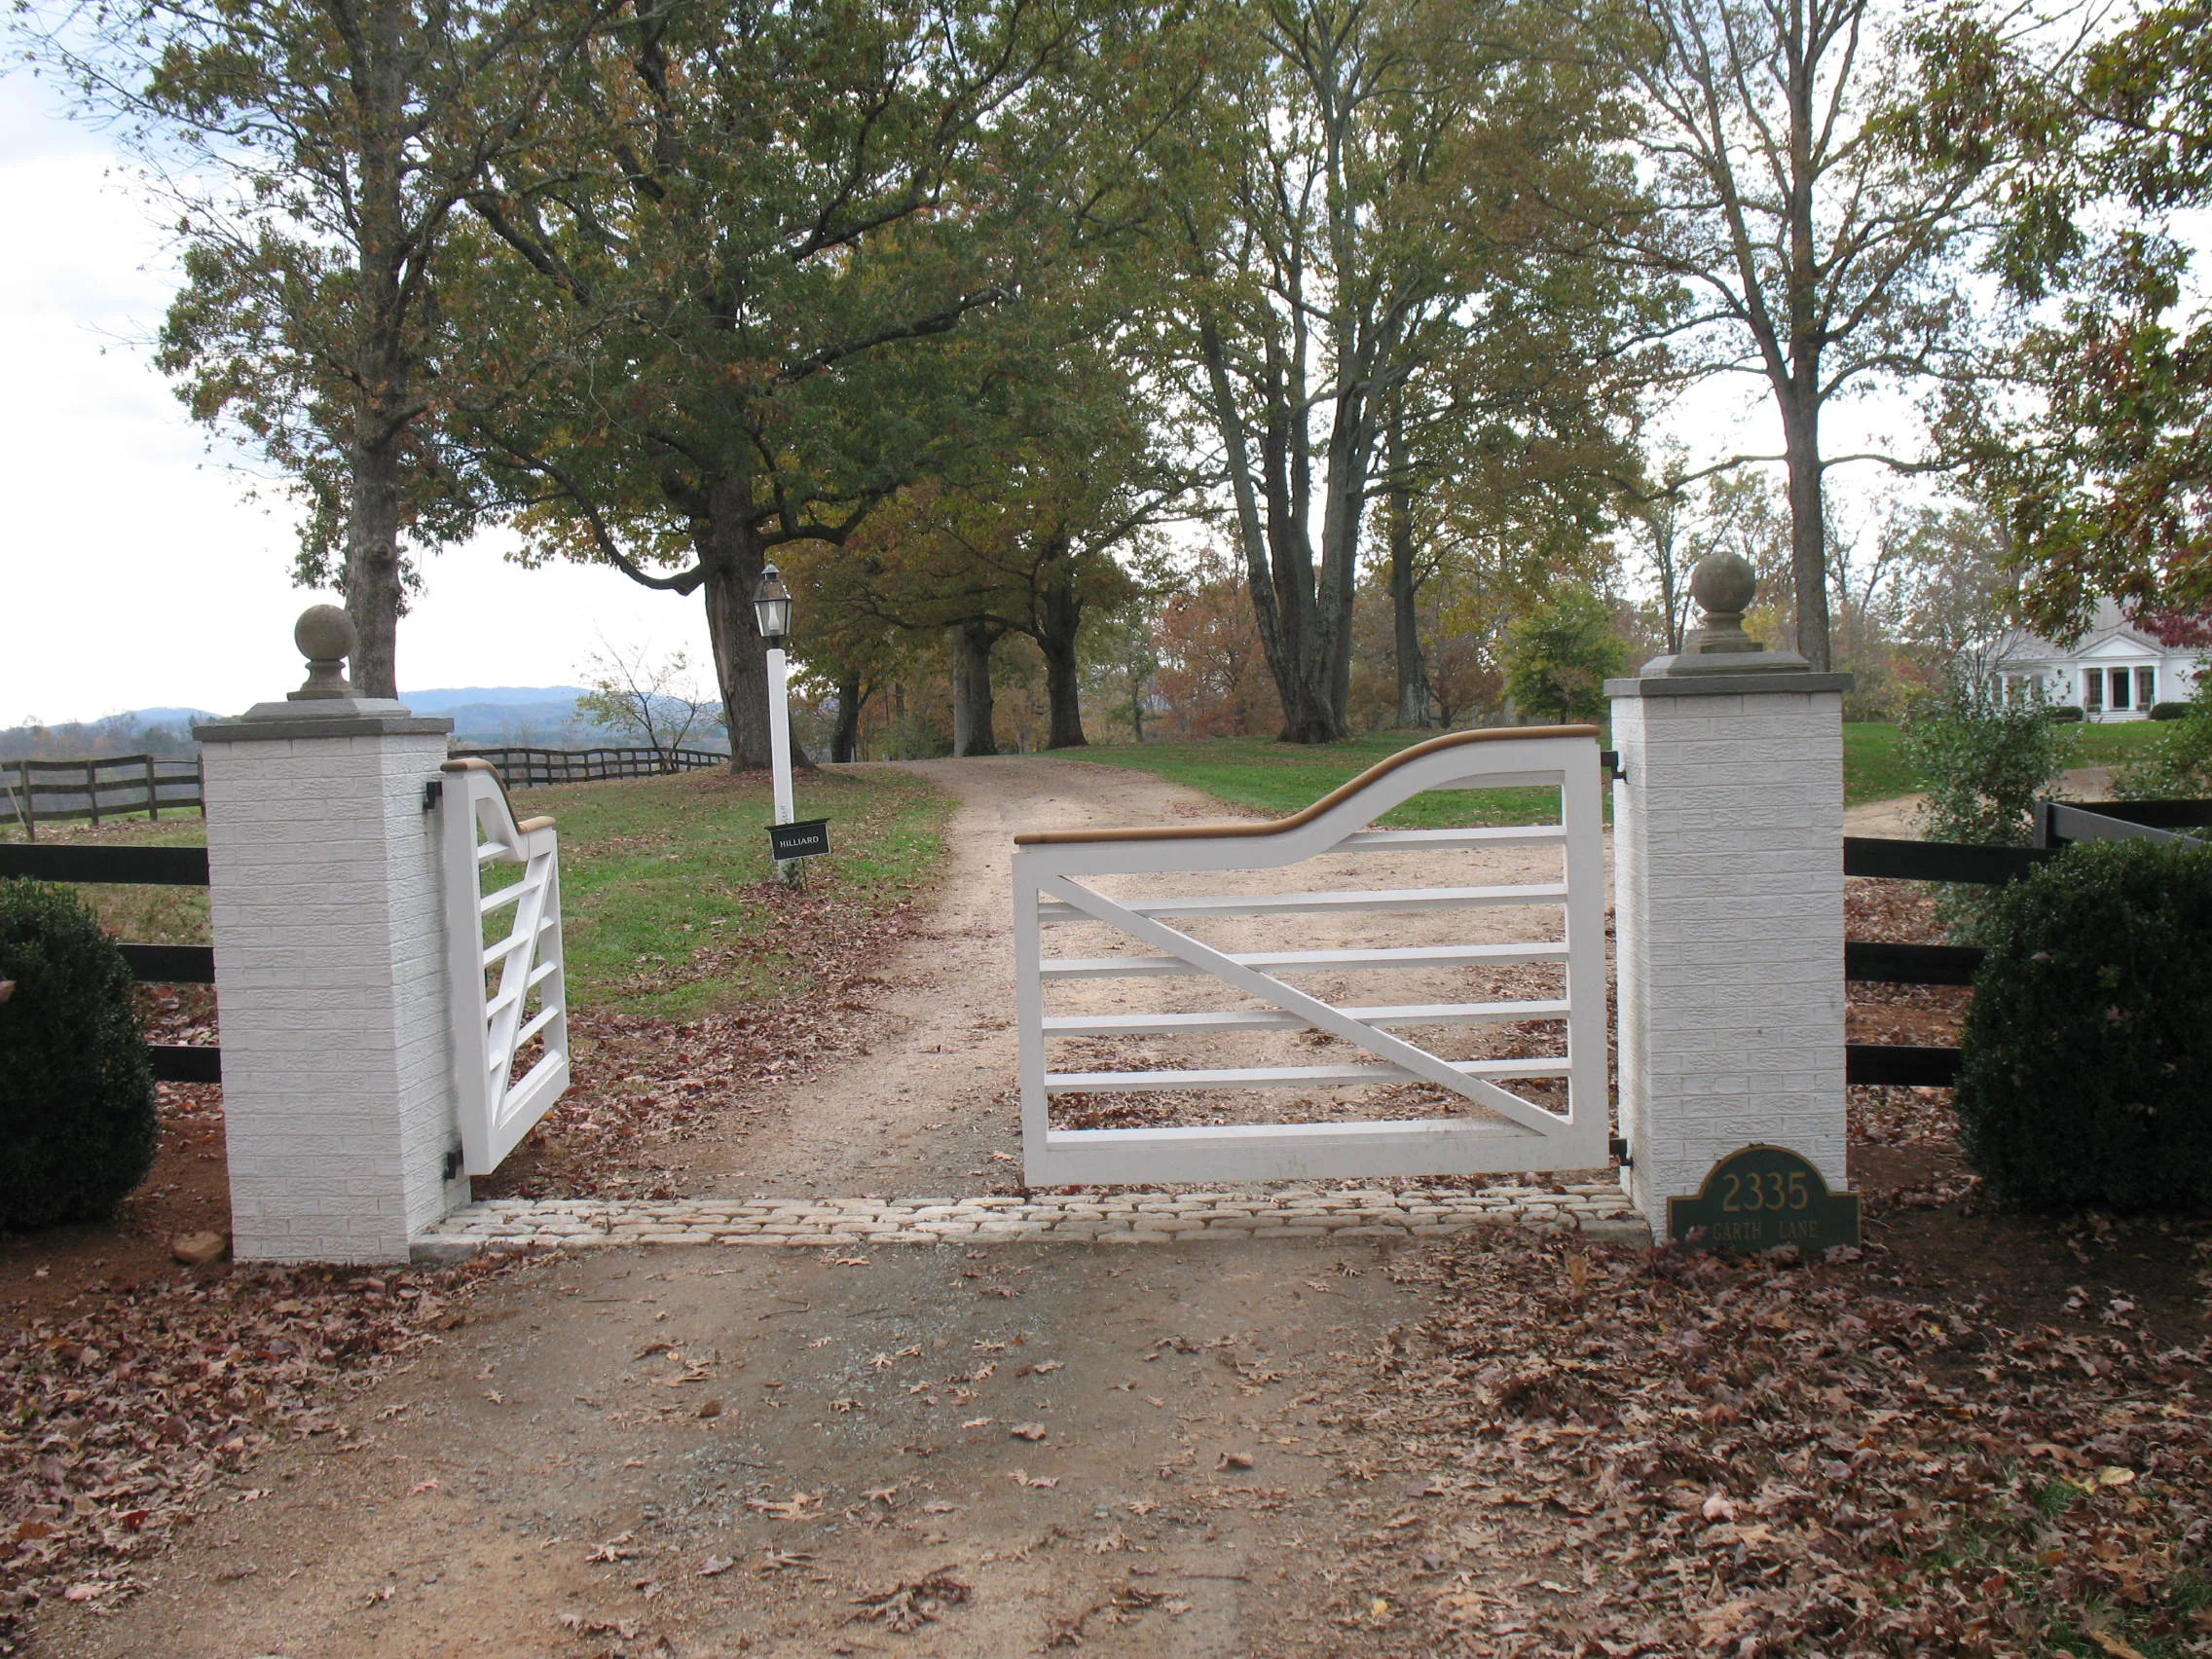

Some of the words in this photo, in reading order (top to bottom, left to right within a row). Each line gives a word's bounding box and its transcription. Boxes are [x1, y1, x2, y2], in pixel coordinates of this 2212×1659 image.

[779, 835, 819, 848] HILLIARD
[1722, 1171, 1808, 1212] 2335
[1713, 1222, 1761, 1241] GARTH
[1779, 1220, 1818, 1239] LANE
